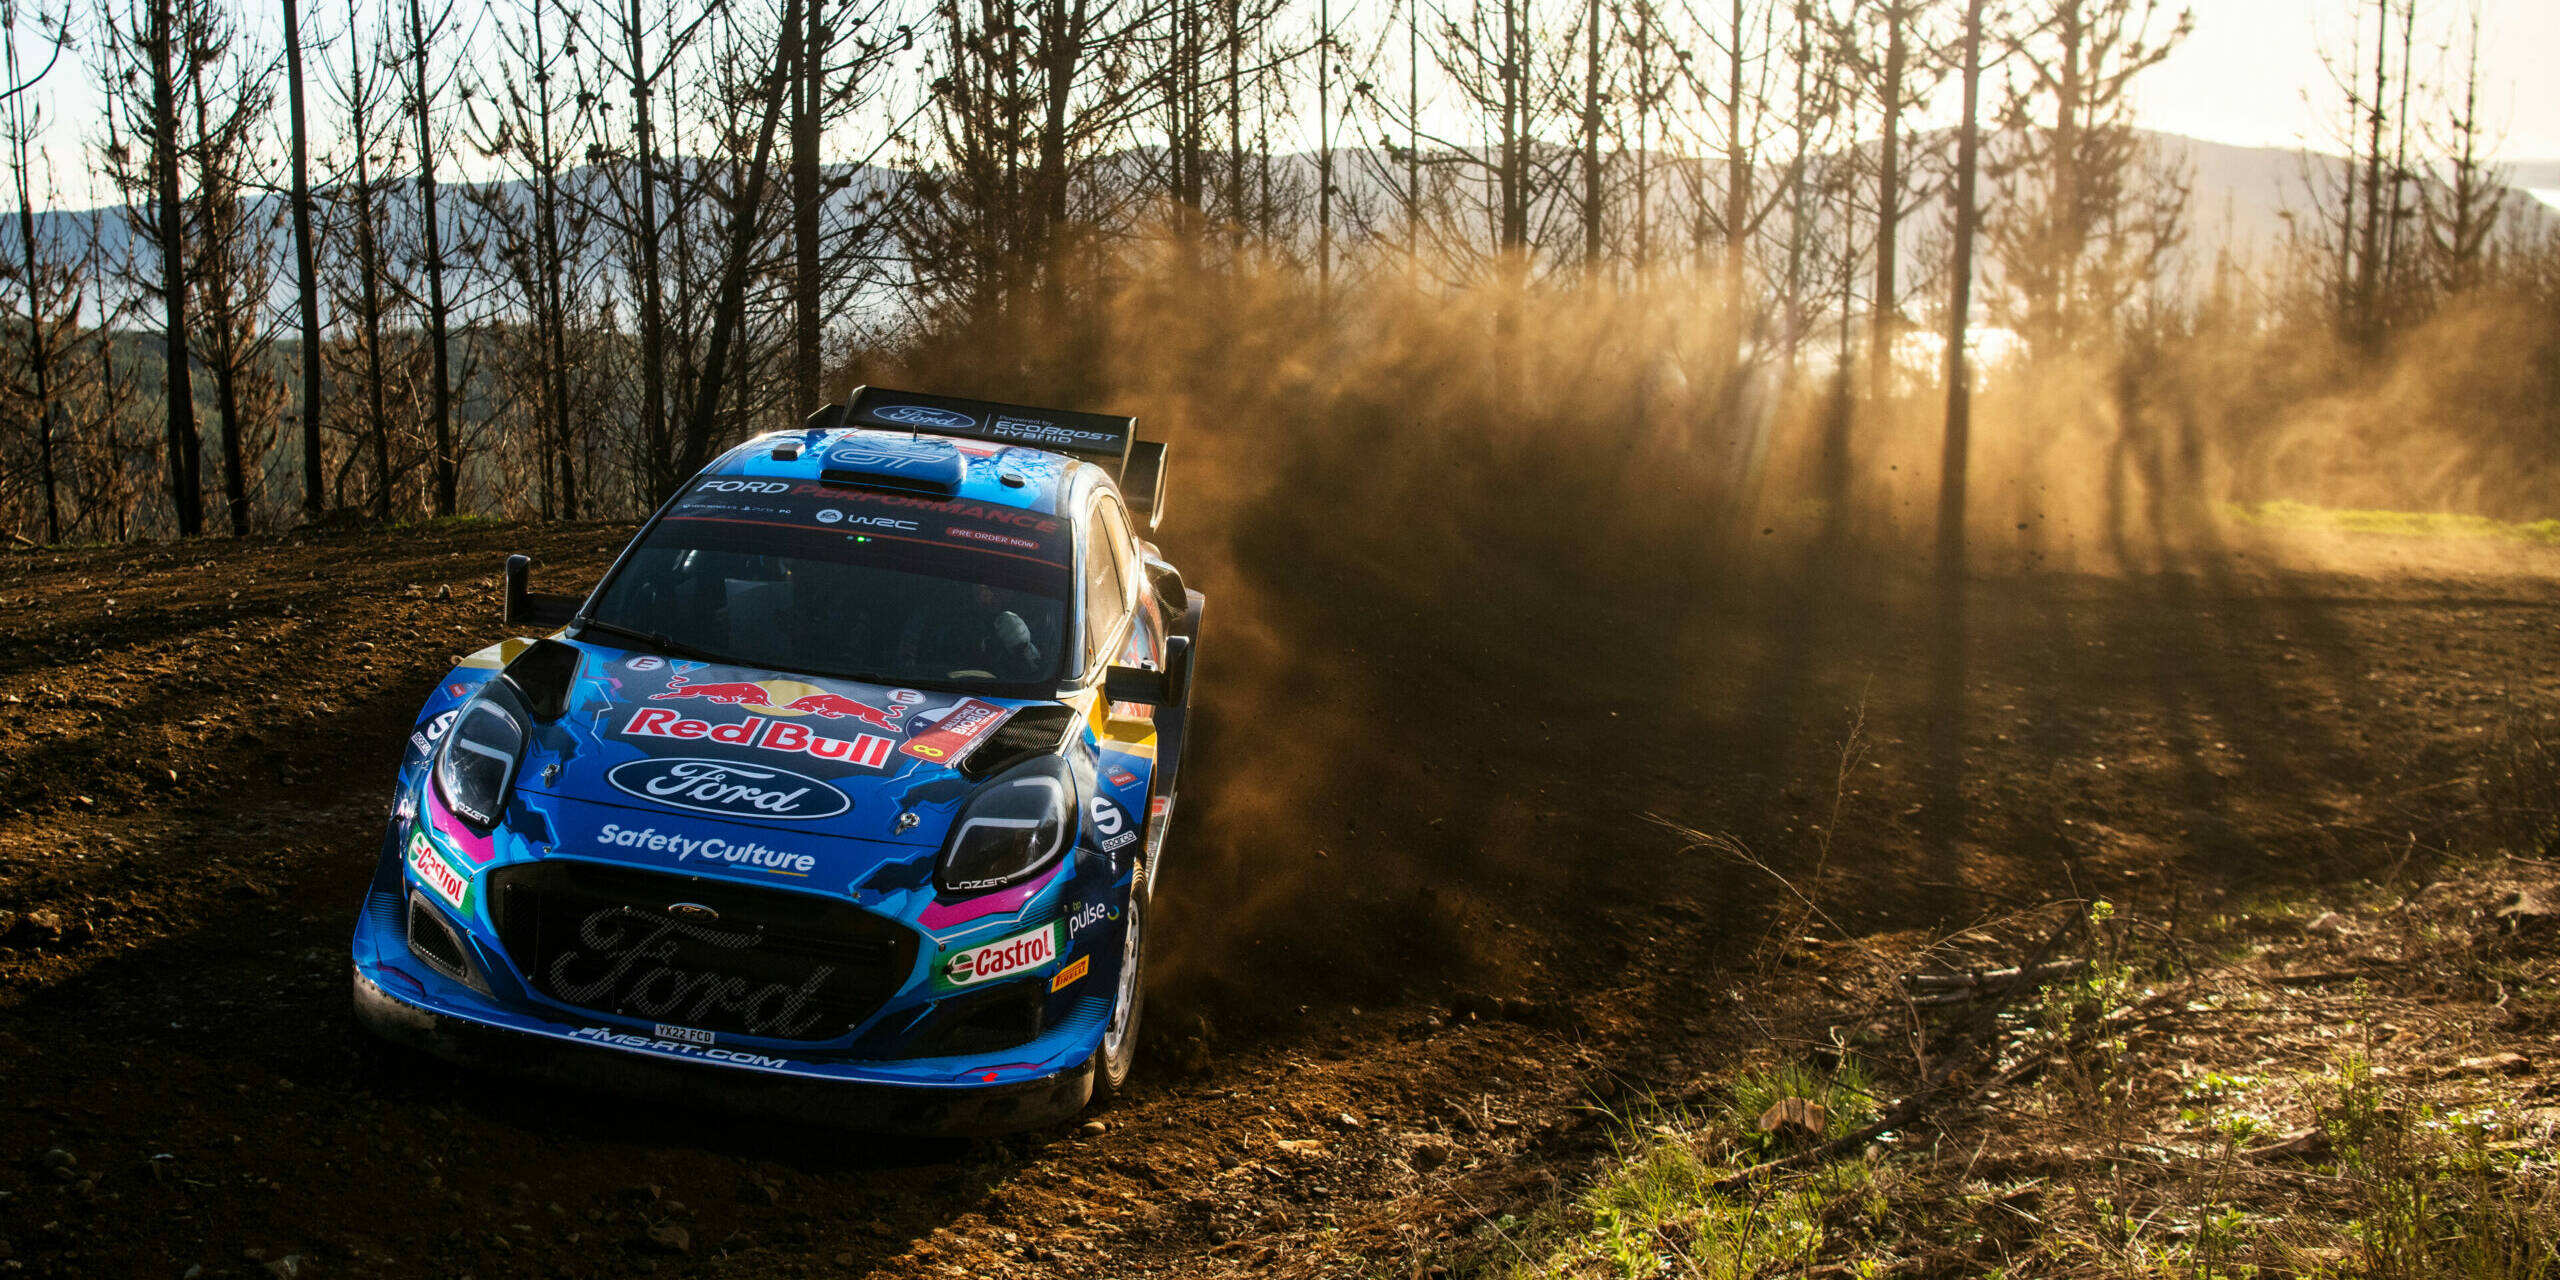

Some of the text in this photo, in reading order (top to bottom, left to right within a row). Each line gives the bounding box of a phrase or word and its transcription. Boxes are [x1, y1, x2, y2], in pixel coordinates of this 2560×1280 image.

[890, 407, 957, 427] Ford
[995, 420, 1120, 441] ECOBOOST
[998, 414, 1054, 428] Powered by
[697, 480, 1061, 533] FORD PERFORMANCE
[848, 514, 919, 531] WRC
[951, 528, 1035, 549] PRE ORDER NOW
[621, 706, 897, 769] Red Bull
[912, 744, 944, 758] 8
[645, 762, 810, 815] Ford
[1091, 796, 1122, 835] S
[597, 823, 816, 872] SafetyCulture
[1103, 832, 1135, 850] sparco
[418, 847, 464, 902] Castrol
[946, 876, 1008, 890] LAZER
[1069, 902, 1106, 940] pulse
[975, 930, 1052, 977] Castrol
[549, 906, 835, 1037] Ford
[1055, 960, 1088, 988] PIRELLI
[592, 1027, 788, 1069] MS-RT.COM
[659, 1025, 712, 1043] YX22 FCD
